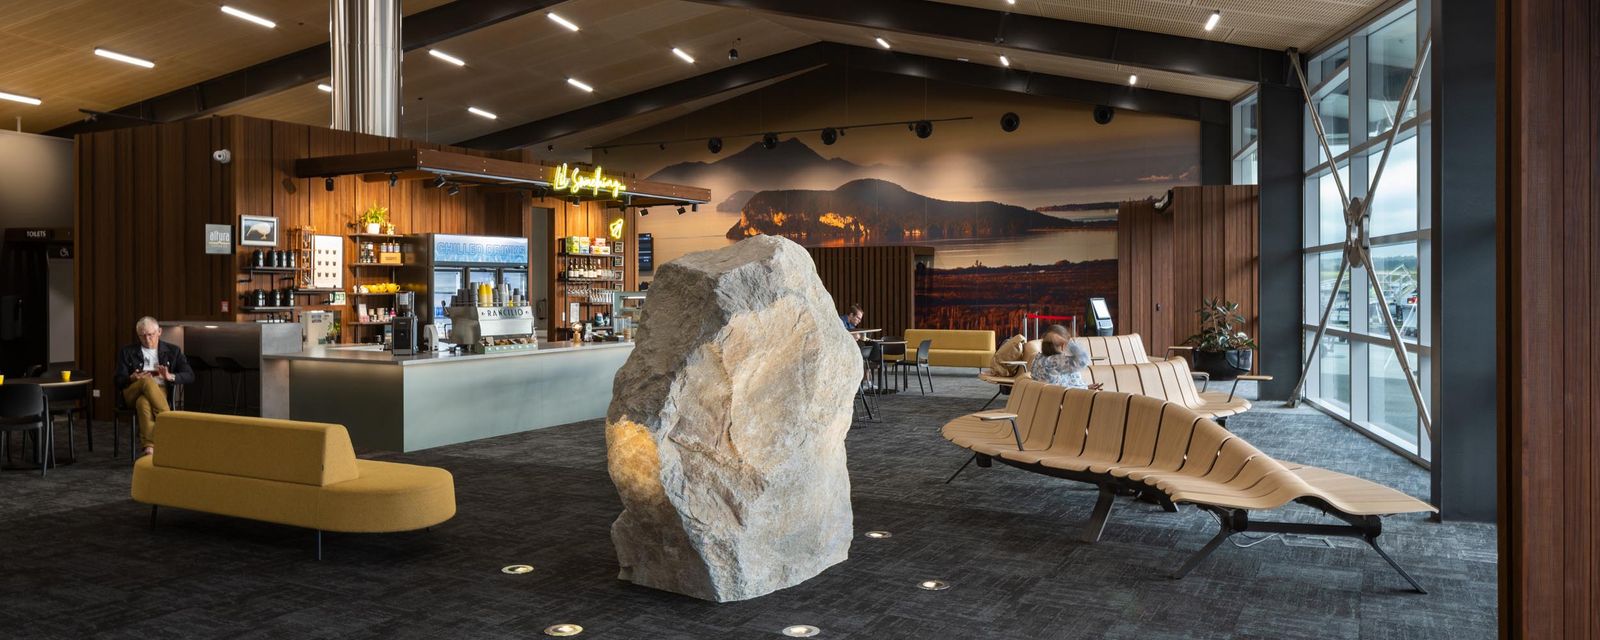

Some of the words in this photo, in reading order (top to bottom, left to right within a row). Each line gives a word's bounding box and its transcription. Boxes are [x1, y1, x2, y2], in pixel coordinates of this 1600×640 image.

[26, 230, 47, 238] TOILETS
[437, 241, 483, 256] CHILLED
[486, 243, 526, 257] DRINKS
[487, 308, 524, 317] RANCILIO
